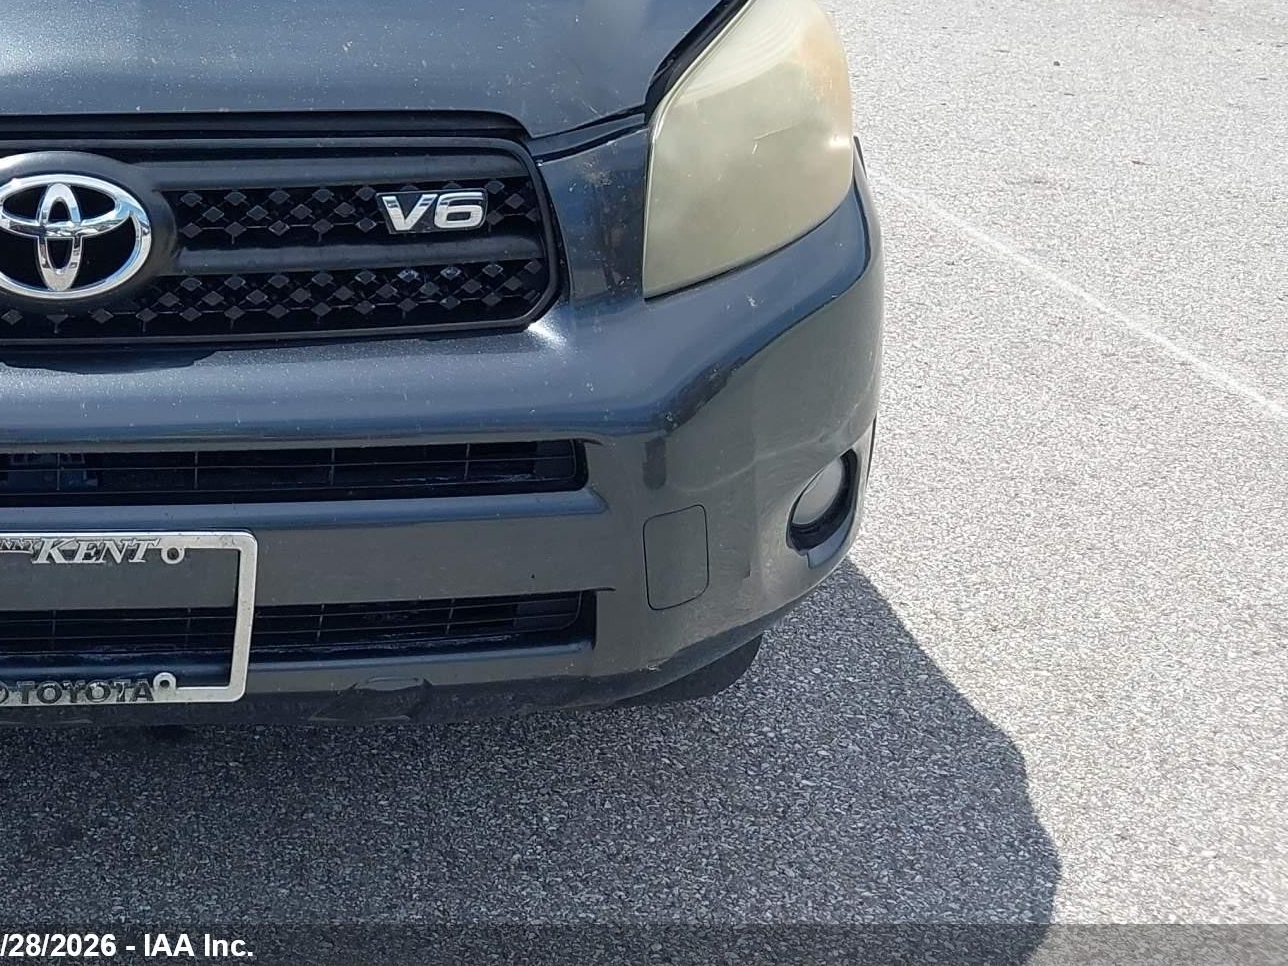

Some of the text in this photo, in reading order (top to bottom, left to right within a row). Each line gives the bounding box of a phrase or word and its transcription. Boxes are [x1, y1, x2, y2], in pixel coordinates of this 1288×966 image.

[381, 190, 485, 232] V6
[31, 537, 161, 565] KENT
[16, 679, 155, 705] TOYOTA
